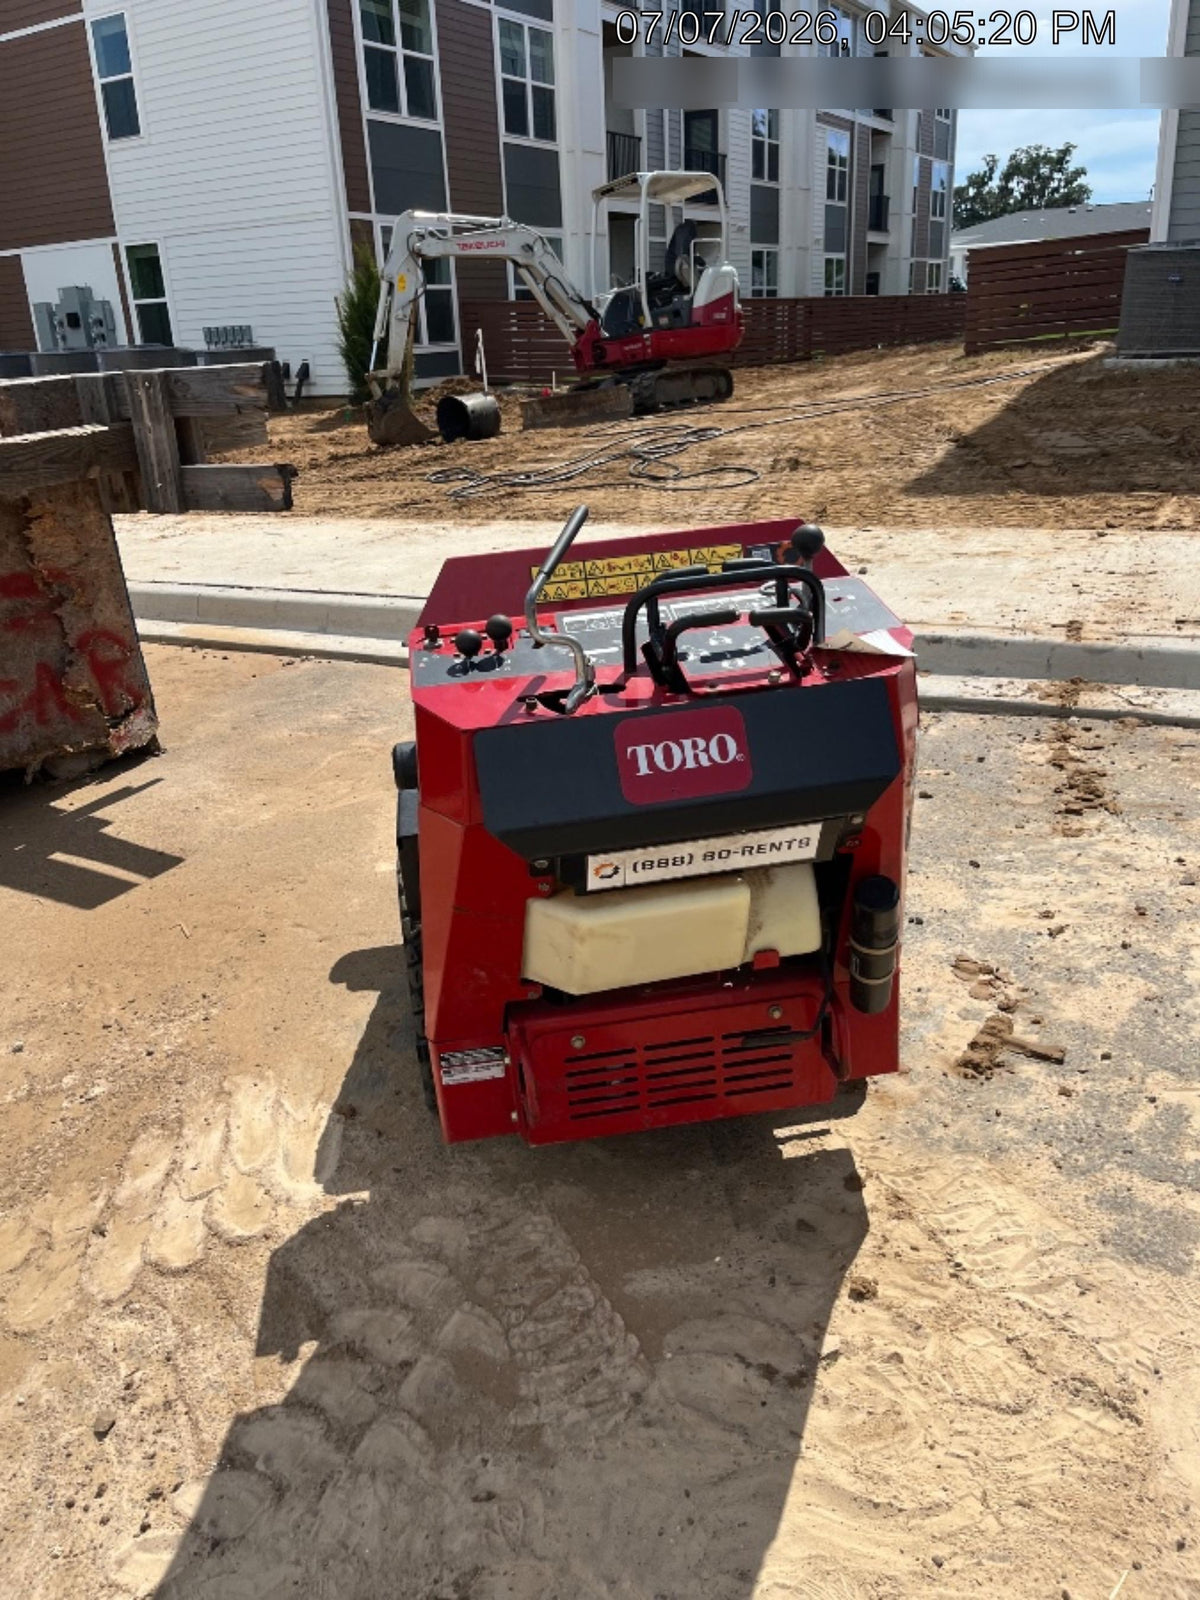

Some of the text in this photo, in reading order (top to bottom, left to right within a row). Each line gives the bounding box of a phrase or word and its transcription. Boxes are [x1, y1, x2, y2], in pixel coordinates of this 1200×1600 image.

[627, 733, 738, 776] TORO
[632, 837, 811, 873] (888) 80-RENTS
